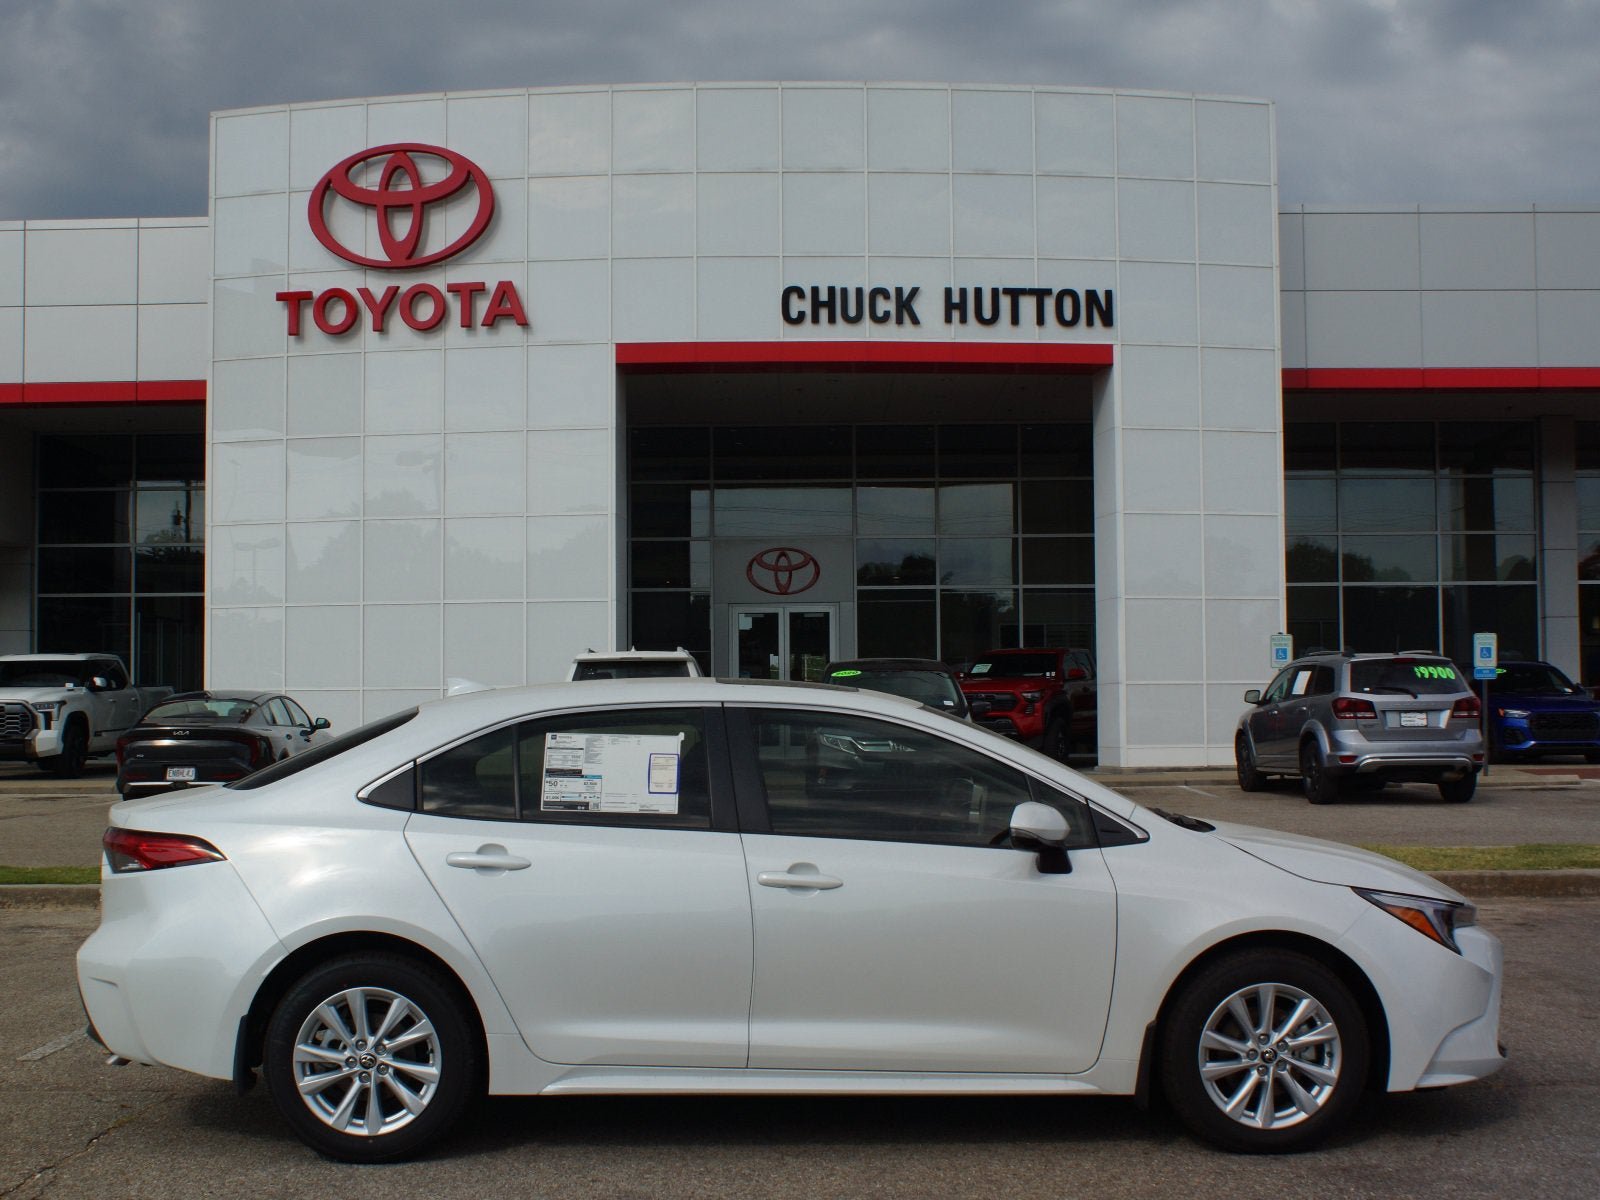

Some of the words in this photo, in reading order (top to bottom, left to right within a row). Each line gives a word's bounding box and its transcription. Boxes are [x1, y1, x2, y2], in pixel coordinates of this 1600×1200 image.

[276, 281, 528, 336] TOYOTA
[781, 285, 921, 325] CHUCK
[944, 286, 1114, 327] HUTTON
